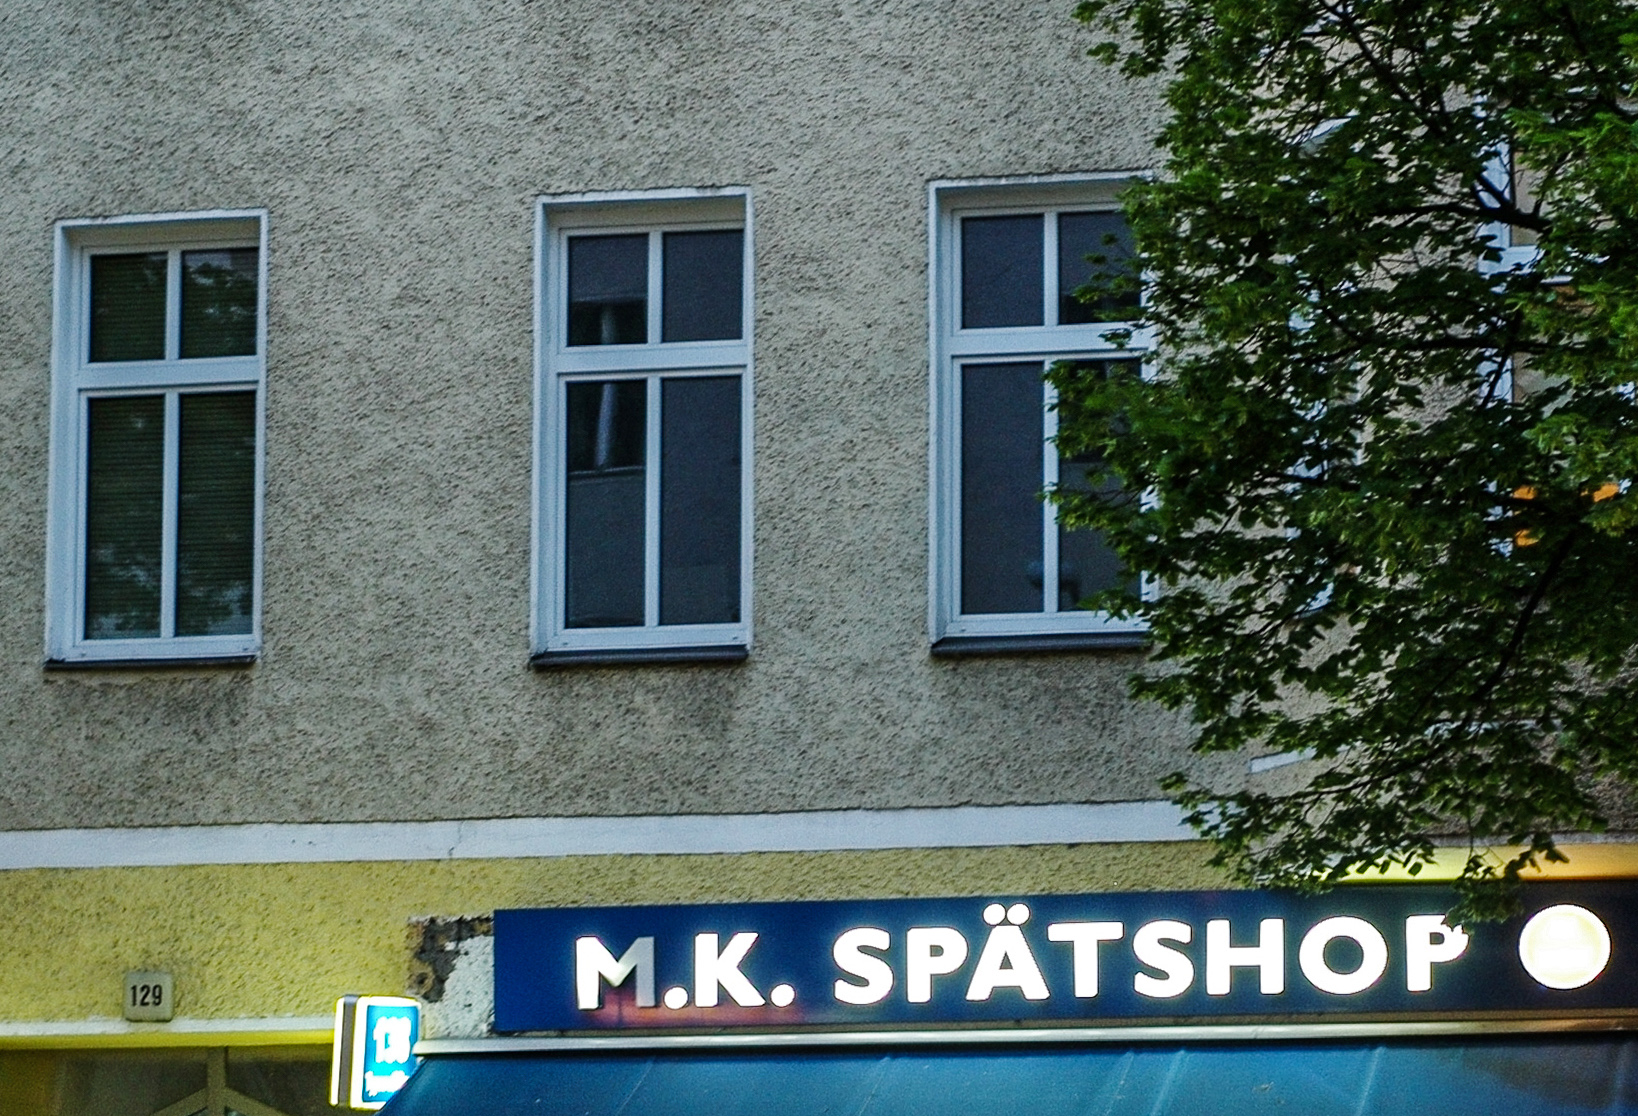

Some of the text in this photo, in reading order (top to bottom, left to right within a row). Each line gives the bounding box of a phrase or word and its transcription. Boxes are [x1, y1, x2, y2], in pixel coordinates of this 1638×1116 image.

[575, 903, 1470, 1012] M.K. SPÄTSHOP
[130, 985, 163, 1007] 129
